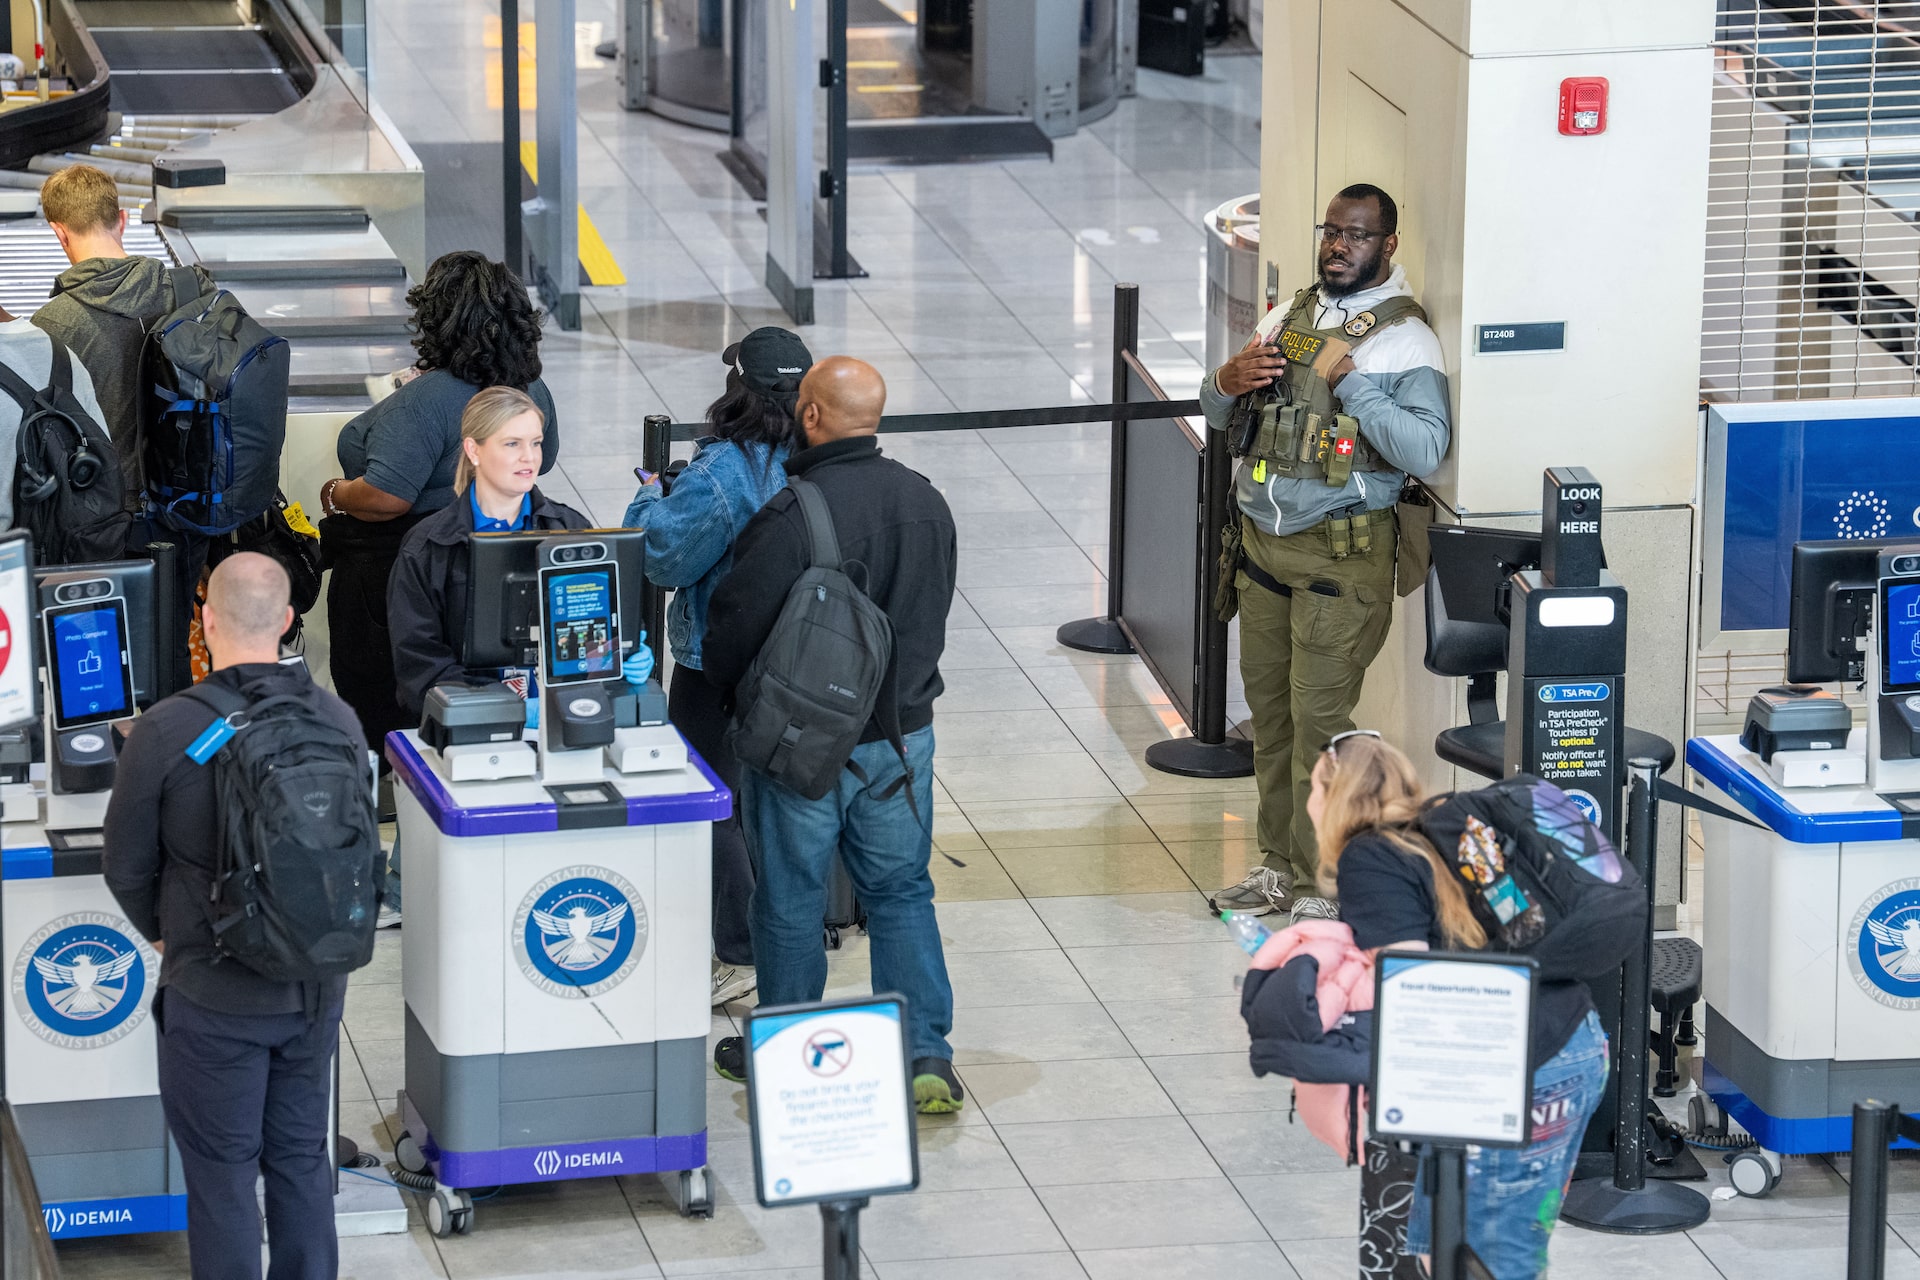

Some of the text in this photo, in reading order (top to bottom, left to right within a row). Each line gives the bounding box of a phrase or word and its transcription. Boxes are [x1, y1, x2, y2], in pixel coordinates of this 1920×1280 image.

[1483, 330, 1515, 339] BT240B
[1281, 331, 1321, 353] POLICE
[1561, 488, 1600, 500] LOOK
[1560, 521, 1598, 534] HERE
[1562, 688, 1577, 697] TSA
[1548, 709, 1599, 719] Participation
[1540, 720, 1547, 728] in
[1549, 719, 1565, 728] TSA
[1548, 728, 1599, 737] Touchless ID
[1551, 737, 1596, 747] is optional.
[1542, 750, 1605, 761] Notify officer if
[1540, 759, 1606, 770] you do not want
[1551, 770, 1576, 779] photo
[1577, 768, 1602, 777] taken.
[514, 866, 648, 945] TRANSPORTATION SECURITY
[13, 912, 159, 994] TRANSPORTATION SECURITY
[1400, 981, 1511, 997] Equal Opportunity Notice
[22, 1006, 147, 1049] ADMINISTRATION
[564, 1151, 624, 1168] IDEMIA
[69, 1208, 133, 1226] IDEMIA
